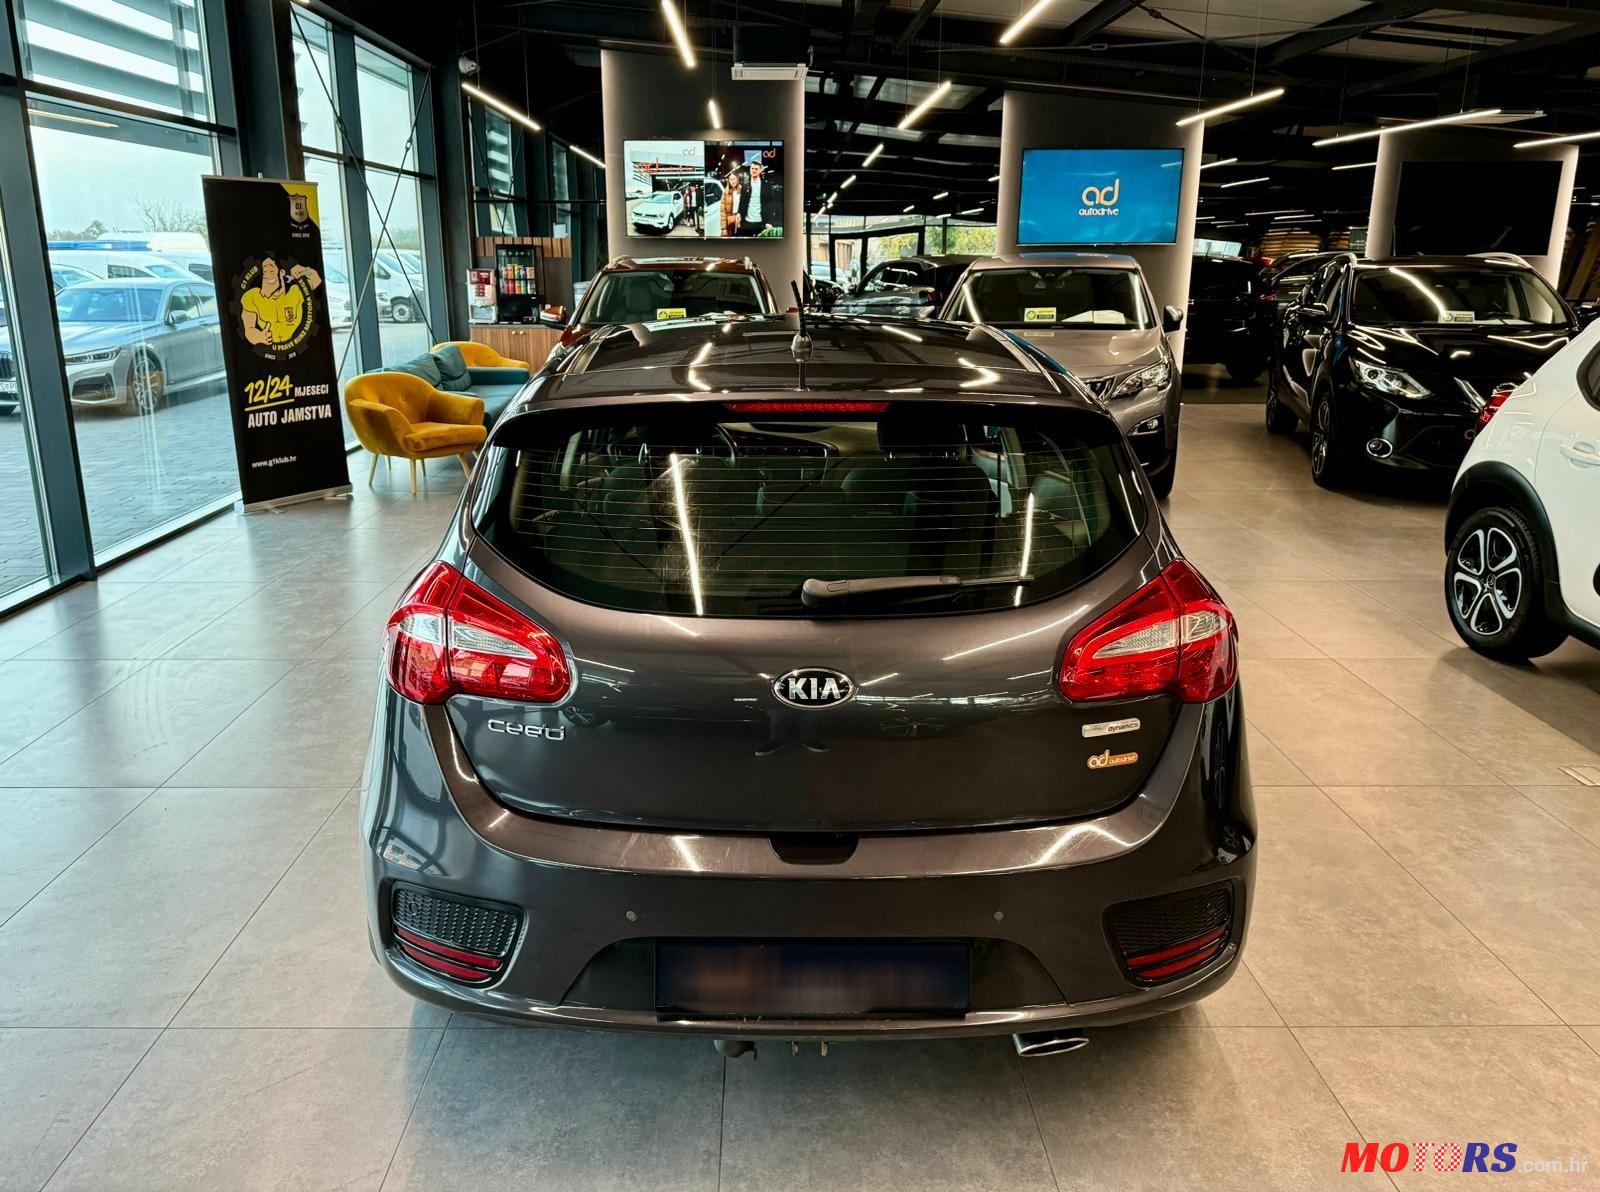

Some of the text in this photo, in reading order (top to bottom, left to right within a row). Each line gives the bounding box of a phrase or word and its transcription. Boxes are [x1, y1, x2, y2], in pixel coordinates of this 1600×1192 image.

[762, 148, 775, 158] ad
[1082, 178, 1119, 206] ad
[1078, 208, 1119, 216] autodrive
[244, 265, 259, 281] KLUB
[244, 374, 329, 405] 12/24 MJESECI
[247, 404, 332, 429] AUTO JAMSTVA
[251, 455, 297, 468] www.g1klub.hr
[787, 677, 841, 700] KIA
[1089, 749, 1110, 768] ad
